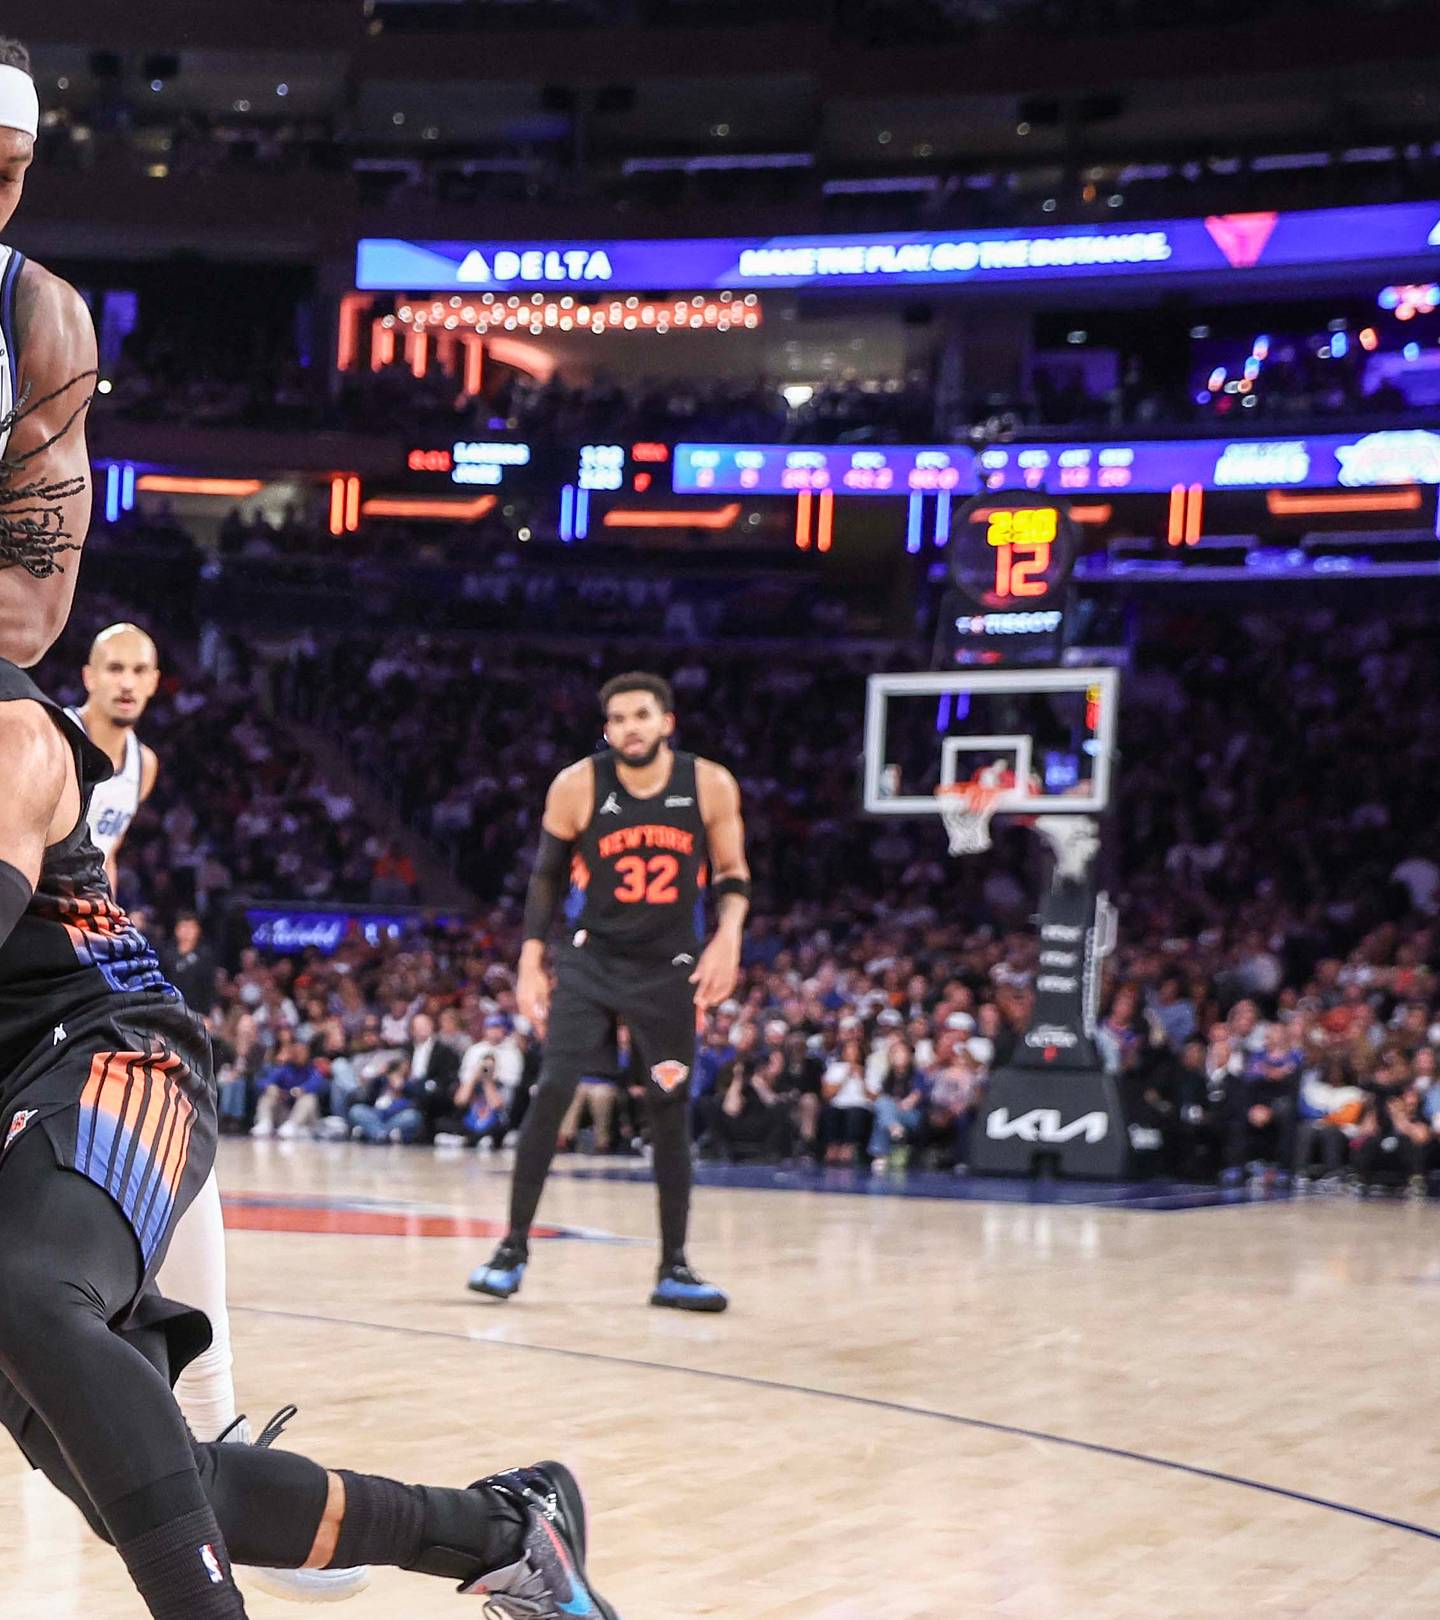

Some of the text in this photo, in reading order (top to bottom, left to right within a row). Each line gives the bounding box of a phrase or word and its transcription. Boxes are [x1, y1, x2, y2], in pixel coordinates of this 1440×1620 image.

[493, 250, 612, 281] DELTA
[995, 542, 1050, 597] 12
[614, 855, 679, 904] 32
[986, 1107, 1108, 1144] KIA
